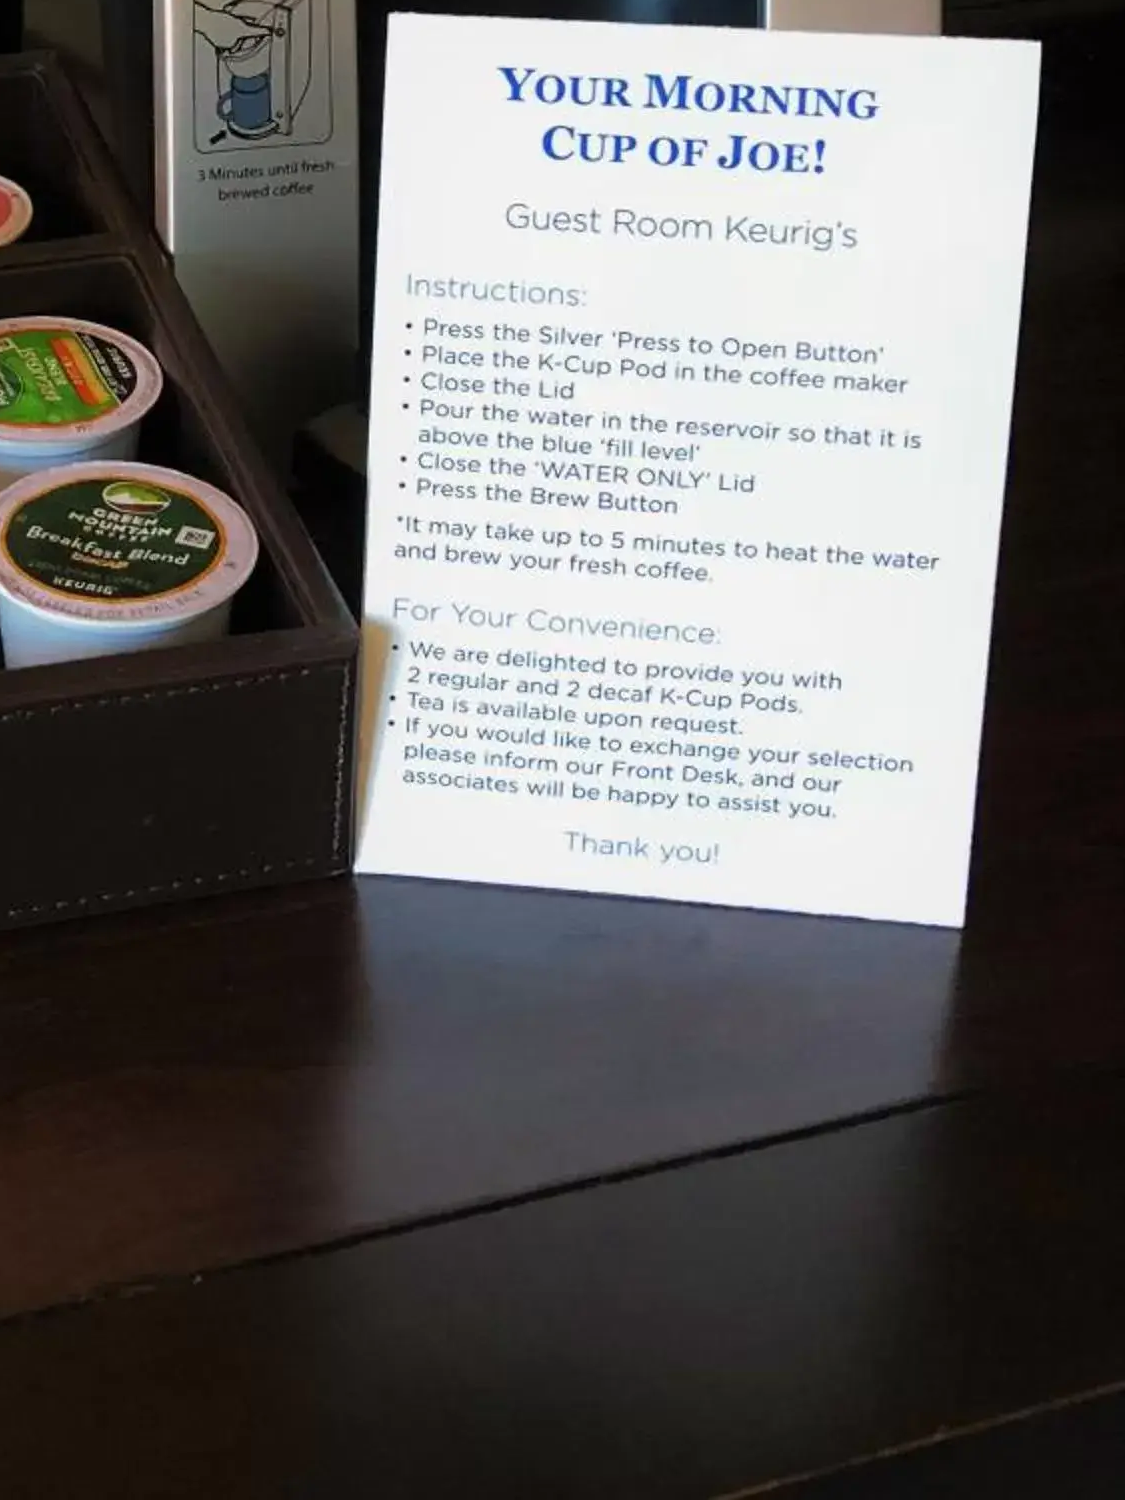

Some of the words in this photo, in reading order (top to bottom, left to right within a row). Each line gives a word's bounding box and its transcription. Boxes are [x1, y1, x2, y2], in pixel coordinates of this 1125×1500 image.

[495, 65, 634, 109] YOUR
[641, 72, 881, 121] MORNING
[197, 169, 206, 181] 3
[208, 166, 264, 181] Minutes
[268, 161, 298, 177] until
[301, 160, 336, 174] fresh
[540, 123, 638, 164] CUP
[646, 134, 709, 168] OF
[715, 133, 827, 175] JOE!
[218, 184, 270, 201] brewed
[272, 181, 315, 196] coffee
[504, 202, 602, 235] Guest
[612, 207, 713, 241] Room
[405, 272, 587, 308] Instructions:
[423, 316, 485, 340] Press
[492, 322, 531, 344] the
[537, 324, 604, 348] Silver
[687, 335, 714, 356] to
[720, 336, 787, 361] Open
[419, 370, 486, 394] Close
[492, 376, 531, 397] the
[537, 379, 575, 401] Lid
[421, 344, 485, 368] Place
[491, 349, 531, 370] the
[537, 352, 613, 379] K-Cup
[619, 357, 667, 380] Pod
[673, 365, 696, 381] in
[702, 363, 743, 384] the
[748, 366, 826, 389] coffee
[832, 372, 909, 394] maker
[417, 425, 489, 448] above
[496, 430, 535, 452] the
[541, 433, 593, 456] blue
[419, 397, 475, 420] Pour
[480, 402, 520, 423] the
[527, 409, 595, 428] water
[601, 410, 622, 430] in
[629, 412, 669, 434] the
[675, 420, 782, 441] reservoir
[787, 426, 817, 444] so
[823, 425, 872, 447] that
[879, 428, 896, 448] it
[902, 434, 922, 450] is
[416, 450, 482, 473] Close
[488, 456, 527, 477] the
[717, 472, 756, 494] Lid
[92, 507, 160, 525] GREEN
[415, 476, 478, 500] Press
[484, 483, 523, 504] the
[529, 485, 591, 509] Brew
[596, 490, 679, 515] Button
[26, 524, 123, 560] Breakfast
[128, 548, 191, 567] Blend
[68, 510, 173, 537] MOUNTAIN
[427, 520, 478, 542] may
[484, 522, 535, 543] take
[541, 530, 573, 549] up
[578, 529, 604, 548] to
[610, 530, 626, 550] 5
[631, 534, 726, 557] minutes
[733, 540, 759, 560] to
[764, 540, 818, 564] heat
[825, 544, 865, 566] the
[871, 550, 940, 571] water
[393, 542, 437, 561] and
[443, 543, 503, 566] brew
[508, 553, 562, 572] your
[568, 553, 627, 577] fresh
[633, 560, 713, 583] coffee.
[391, 596, 442, 622] For
[450, 601, 518, 629] Your
[525, 607, 721, 646] Convenience:
[408, 640, 447, 662] We
[452, 647, 490, 666] are
[495, 648, 607, 675] delighted
[612, 658, 639, 677] to
[644, 663, 735, 684] provide
[740, 670, 785, 688] you
[791, 670, 843, 692] with
[406, 665, 421, 684] 2
[427, 671, 510, 692] regular
[515, 678, 560, 697] and
[565, 679, 581, 699] 2
[586, 682, 654, 704] decaf
[659, 686, 733, 711] K-Cup
[739, 691, 803, 715] Pods.
[406, 690, 445, 712] Tea
[451, 699, 470, 714] is
[475, 701, 577, 723] available
[583, 710, 644, 729] upon
[649, 715, 744, 736] request.
[405, 715, 422, 734] If
[426, 722, 469, 740] you
[475, 726, 546, 747] would
[552, 729, 592, 751] like
[598, 734, 623, 753] to
[628, 737, 741, 763] exchange
[747, 747, 801, 766] your
[806, 749, 914, 773] selection
[403, 741, 477, 766] please
[483, 750, 559, 773] inform
[565, 759, 604, 776] our
[611, 759, 674, 782] Front
[681, 764, 745, 788] Desk,
[750, 771, 795, 790] and
[801, 776, 843, 794] our
[401, 768, 520, 795] associates
[526, 779, 565, 799] will
[571, 781, 601, 801] be
[607, 784, 680, 810] happy
[686, 791, 711, 810] to
[716, 795, 781, 814] assist
[787, 801, 837, 820] you.
[563, 829, 649, 858] Thank
[659, 842, 720, 865] you!
